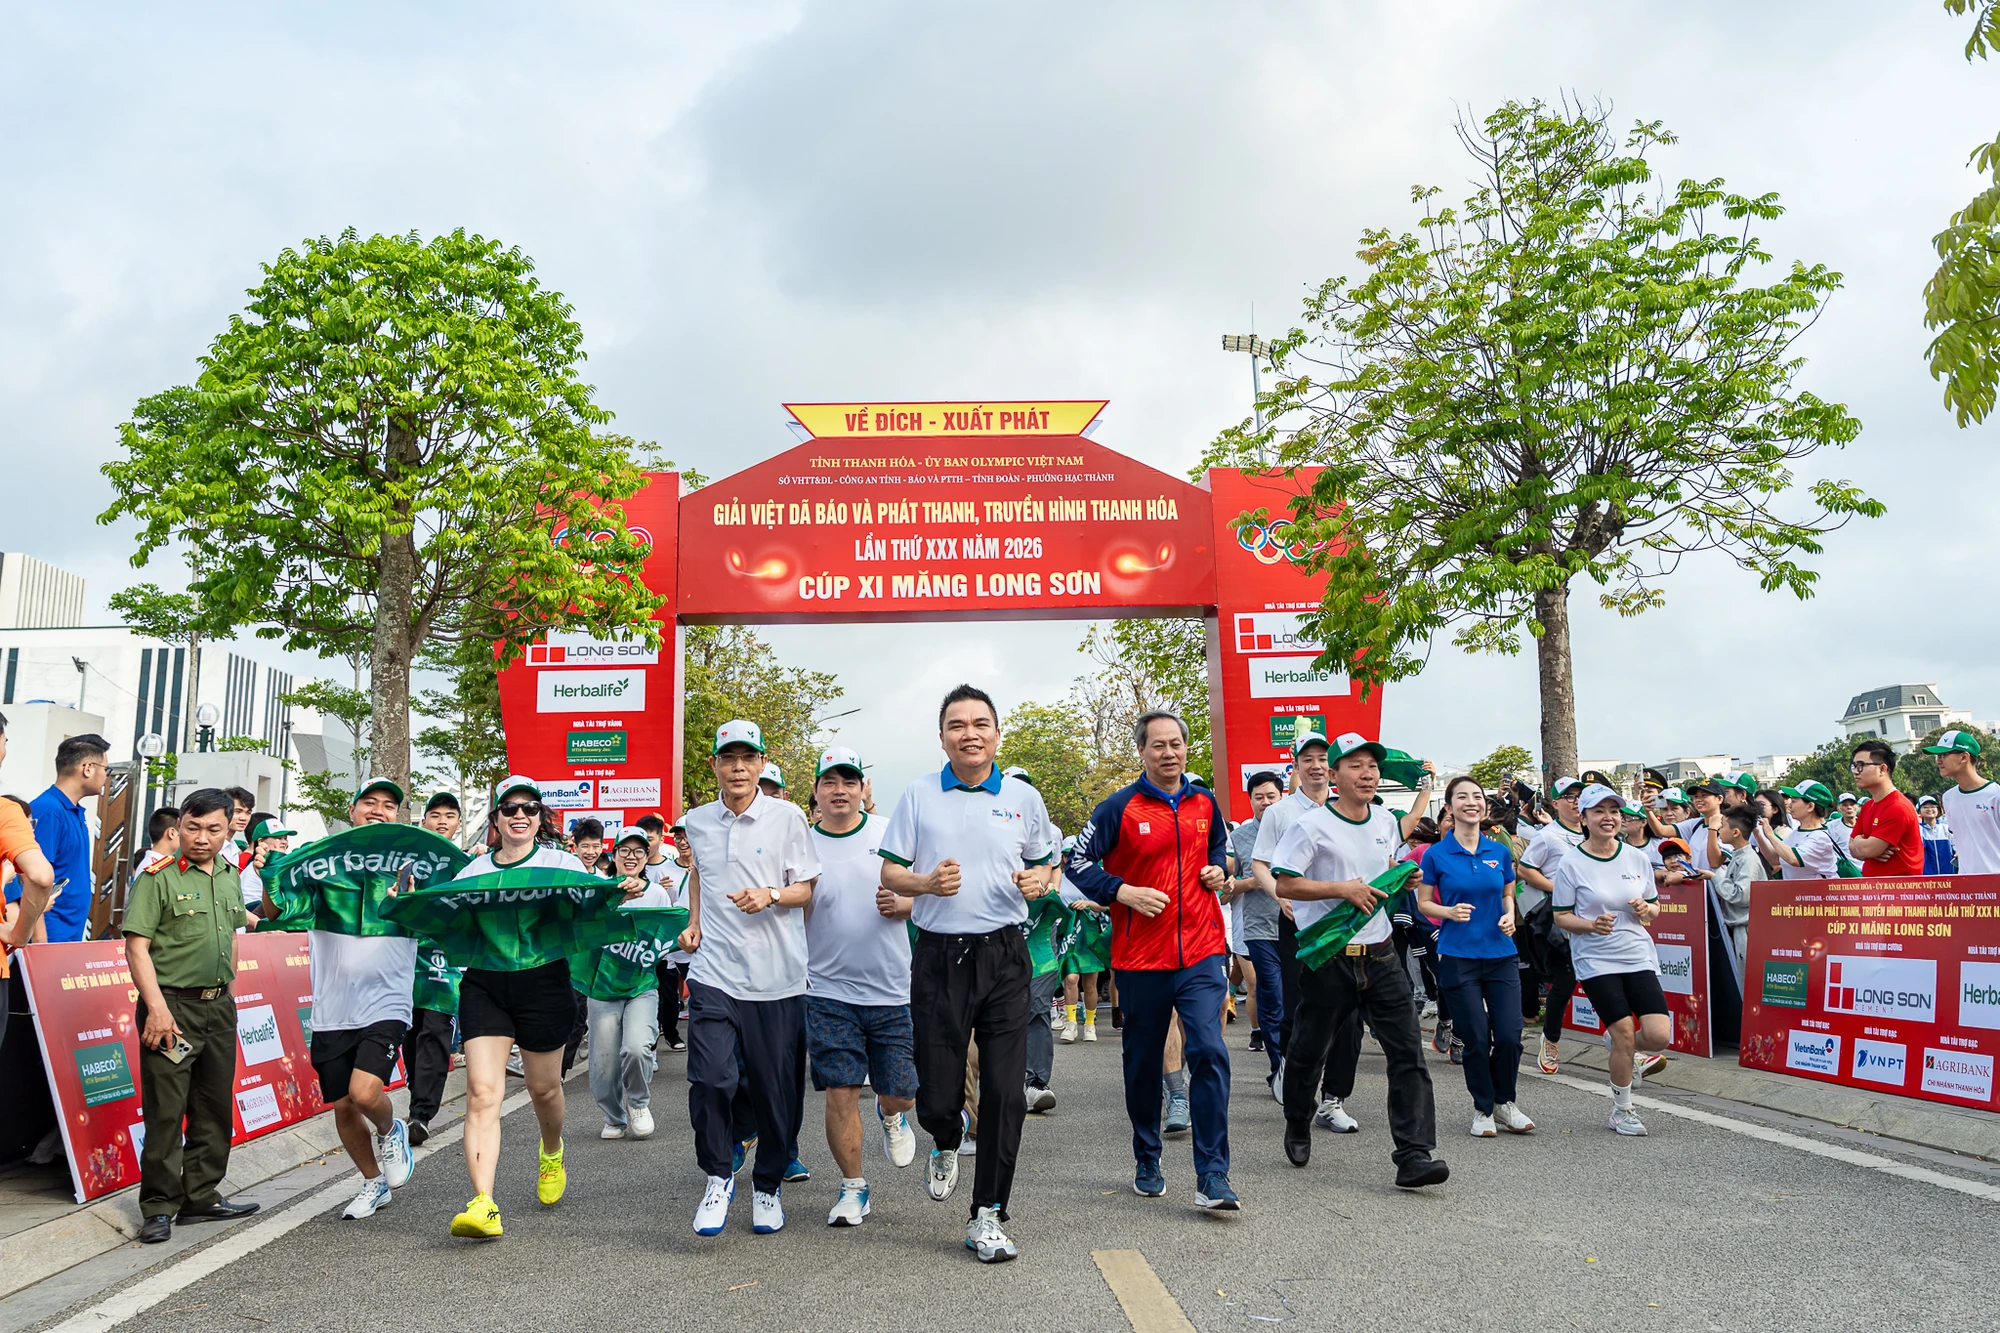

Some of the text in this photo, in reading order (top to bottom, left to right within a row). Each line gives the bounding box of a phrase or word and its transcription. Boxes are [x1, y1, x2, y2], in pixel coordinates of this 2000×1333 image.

[845, 407, 869, 432] VỀ
[875, 409, 922, 432] ĐÍCH
[943, 405, 993, 431] XUẤT
[999, 407, 1050, 430] PHÁT
[809, 454, 1084, 469] TỈNH THANH HÓA ỦY BAN OLYMPIC VIỆT NAM
[778, 472, 1115, 486] SỞ VHTT&DL CÔNG AN TỈNH BÁO VÀ PTTH TỈNH ĐOÀN PHƯỜNG HẠC THÀNH
[713, 493, 1179, 530] GIẢI VIỆT DÃ BÁO VÀ PHÁT THANH, TRUYỀN HÌNH THANH HÓA
[854, 531, 1043, 562] LẦN THỨ XXX NĂM 2026
[798, 568, 1101, 600] CÚP XI MĂNG LONG SƠN
[567, 645, 654, 657] LONG SON
[1264, 669, 1329, 684] Herbalife
[554, 683, 623, 698] Herbalife
[1275, 723, 1295, 732] HAB
[571, 739, 612, 748] HABECO
[541, 789, 580, 798] etinBank
[610, 786, 658, 795] AGRIBANK
[604, 820, 622, 828] PT
[1828, 882, 1841, 891] TỈNH
[1841, 883, 1860, 891] THANH
[1860, 882, 1872, 890] HÓA
[1884, 882, 1896, 890] BAN
[1896, 881, 1922, 890] OLYMPIC
[1922, 880, 1937, 890] VIỆT
[1937, 880, 1952, 889] NAM
[1960, 892, 1974, 901] HẠC
[1974, 891, 1997, 900] THÀNH
[1904, 905, 1927, 917] THANH
[1928, 903, 1943, 918] HÓA
[1960, 903, 1976, 918] THỨ
[1976, 905, 1992, 918] XXX
[1827, 920, 1952, 937] CÚP XI MĂNG LONG SƠN
[603, 939, 656, 968] alife
[1766, 973, 1797, 985] HABECO
[1855, 988, 1932, 1010] LONG SON
[1854, 1004, 1894, 1014] CEMENT
[239, 1022, 275, 1046] Herbalife
[1794, 1042, 1826, 1056] VietinBank
[81, 1059, 117, 1077] HABECO
[1869, 1054, 1904, 1070] VNPT
[1935, 1060, 1991, 1078] AGRIBANK
[1936, 1080, 1955, 1090] NHÁNH
[1955, 1083, 1973, 1093] THANH
